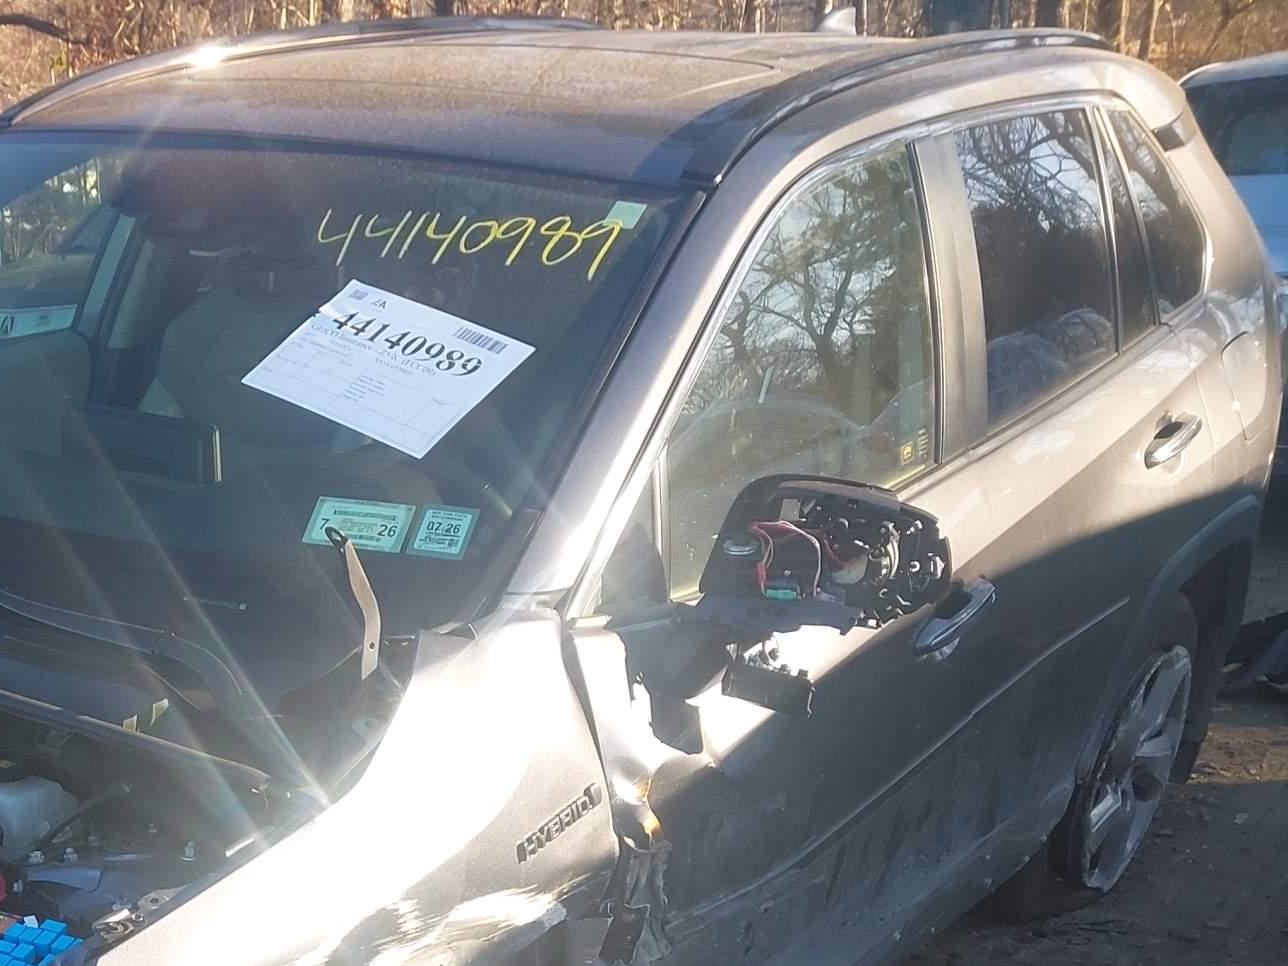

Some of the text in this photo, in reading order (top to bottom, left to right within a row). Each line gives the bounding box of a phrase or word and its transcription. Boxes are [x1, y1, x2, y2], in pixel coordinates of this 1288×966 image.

[317, 208, 625, 281] 44140989
[332, 311, 483, 377] 44140989
[319, 517, 398, 538] 7 26
[444, 523, 462, 535] 26
[515, 782, 602, 864] HYBRID
